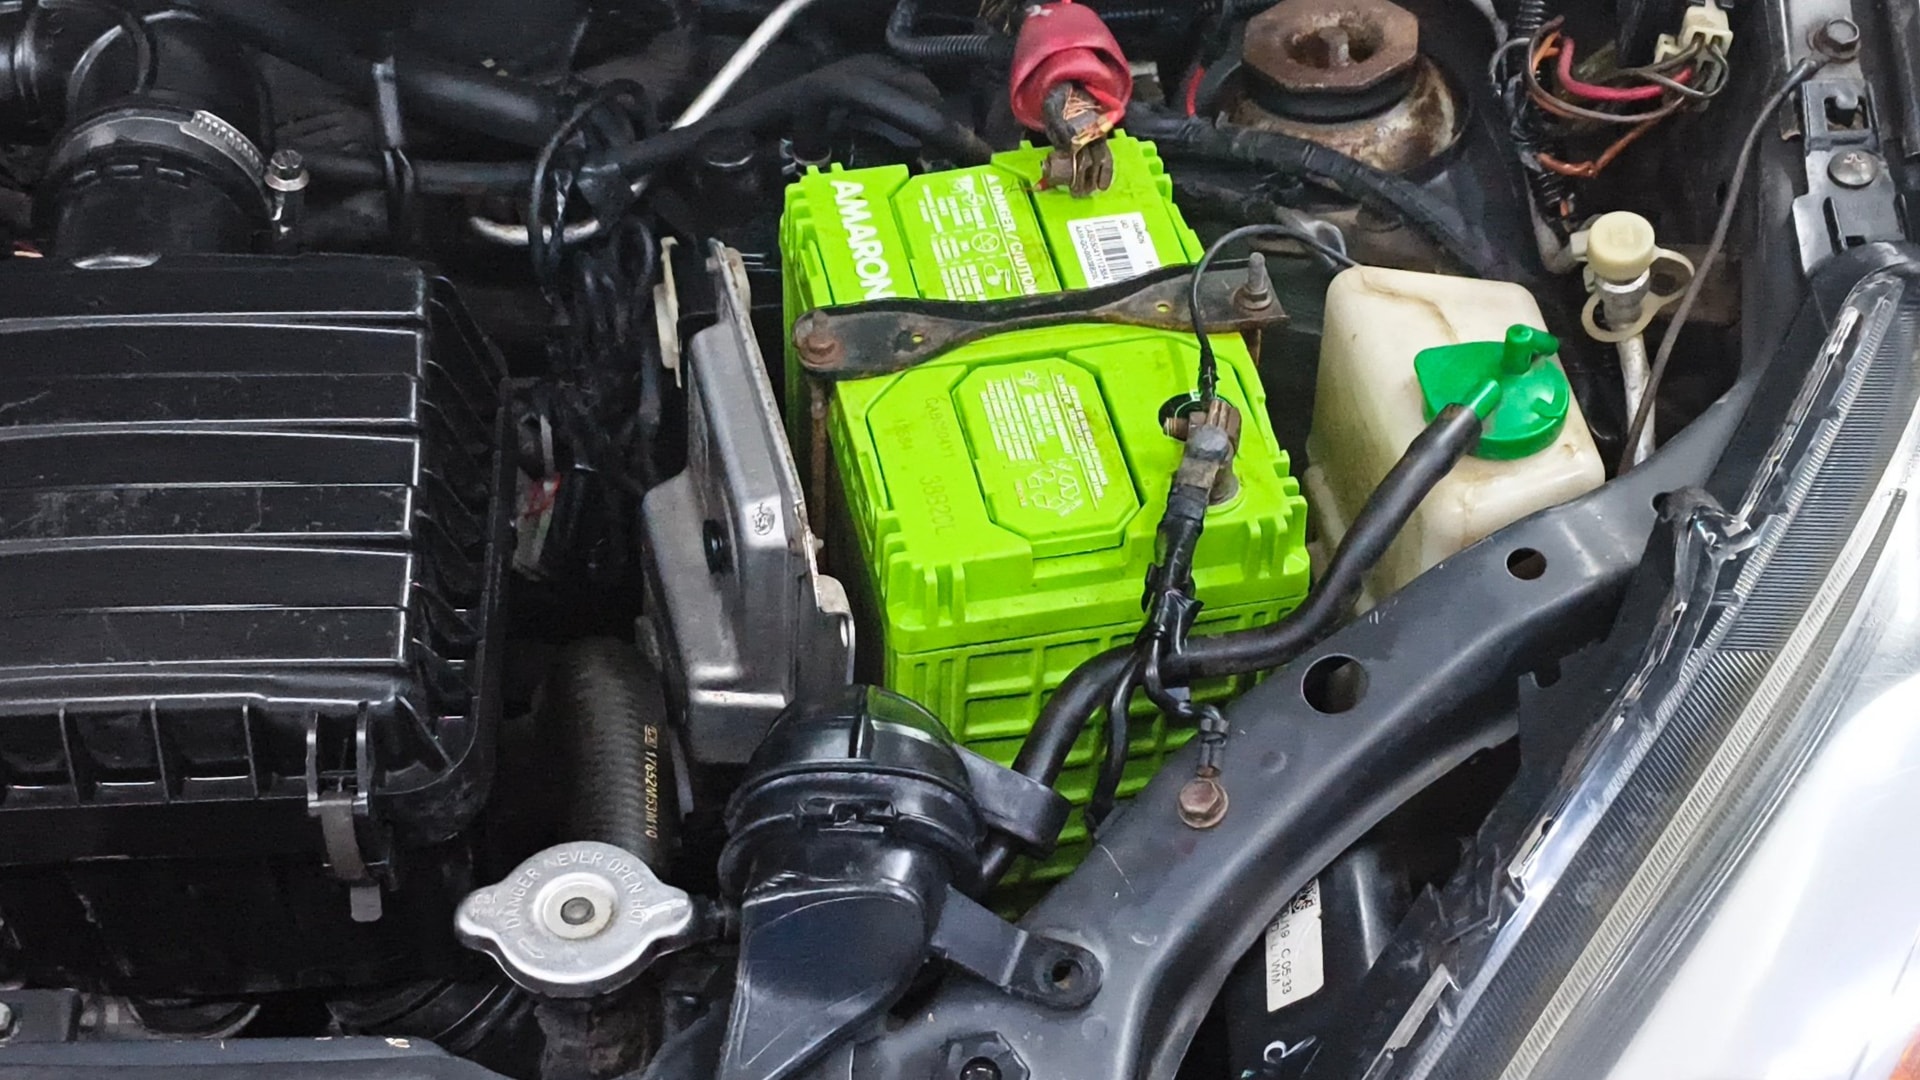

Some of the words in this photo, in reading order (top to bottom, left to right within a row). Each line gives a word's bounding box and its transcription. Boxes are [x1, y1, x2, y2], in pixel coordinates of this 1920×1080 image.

[829, 180, 897, 300] AMARON
[990, 185, 1017, 232] DANGER
[1010, 241, 1039, 295] CAUTION
[505, 867, 542, 930] DANGER
[542, 851, 604, 868] NEVER
[607, 858, 645, 894] OPEN
[628, 898, 648, 927] HOT
